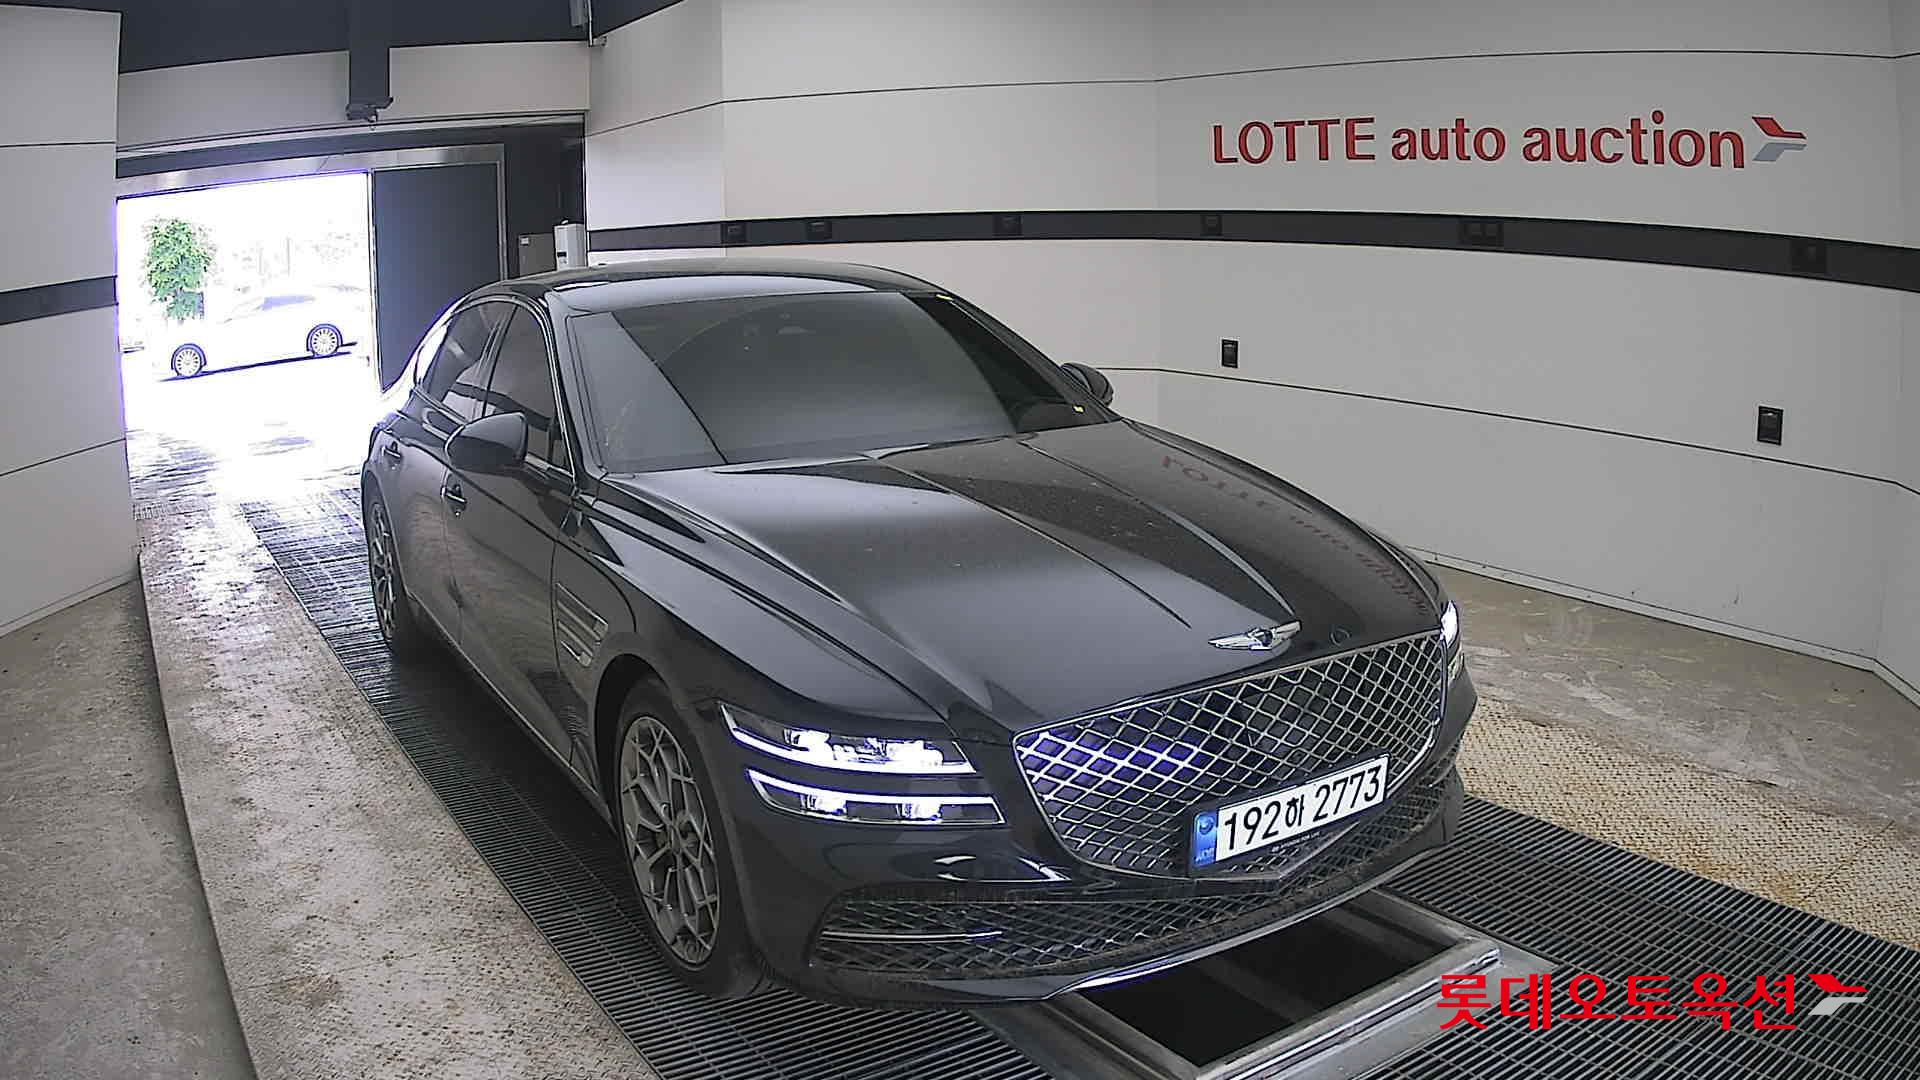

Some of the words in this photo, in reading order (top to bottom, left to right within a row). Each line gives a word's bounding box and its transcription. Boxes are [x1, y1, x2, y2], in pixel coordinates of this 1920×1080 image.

[1212, 116, 1376, 164] LOTTE
[1390, 117, 1506, 162] auto
[1522, 110, 1745, 169] auction
[1224, 794, 1305, 850] 192하
[1312, 765, 1383, 823] 2773
